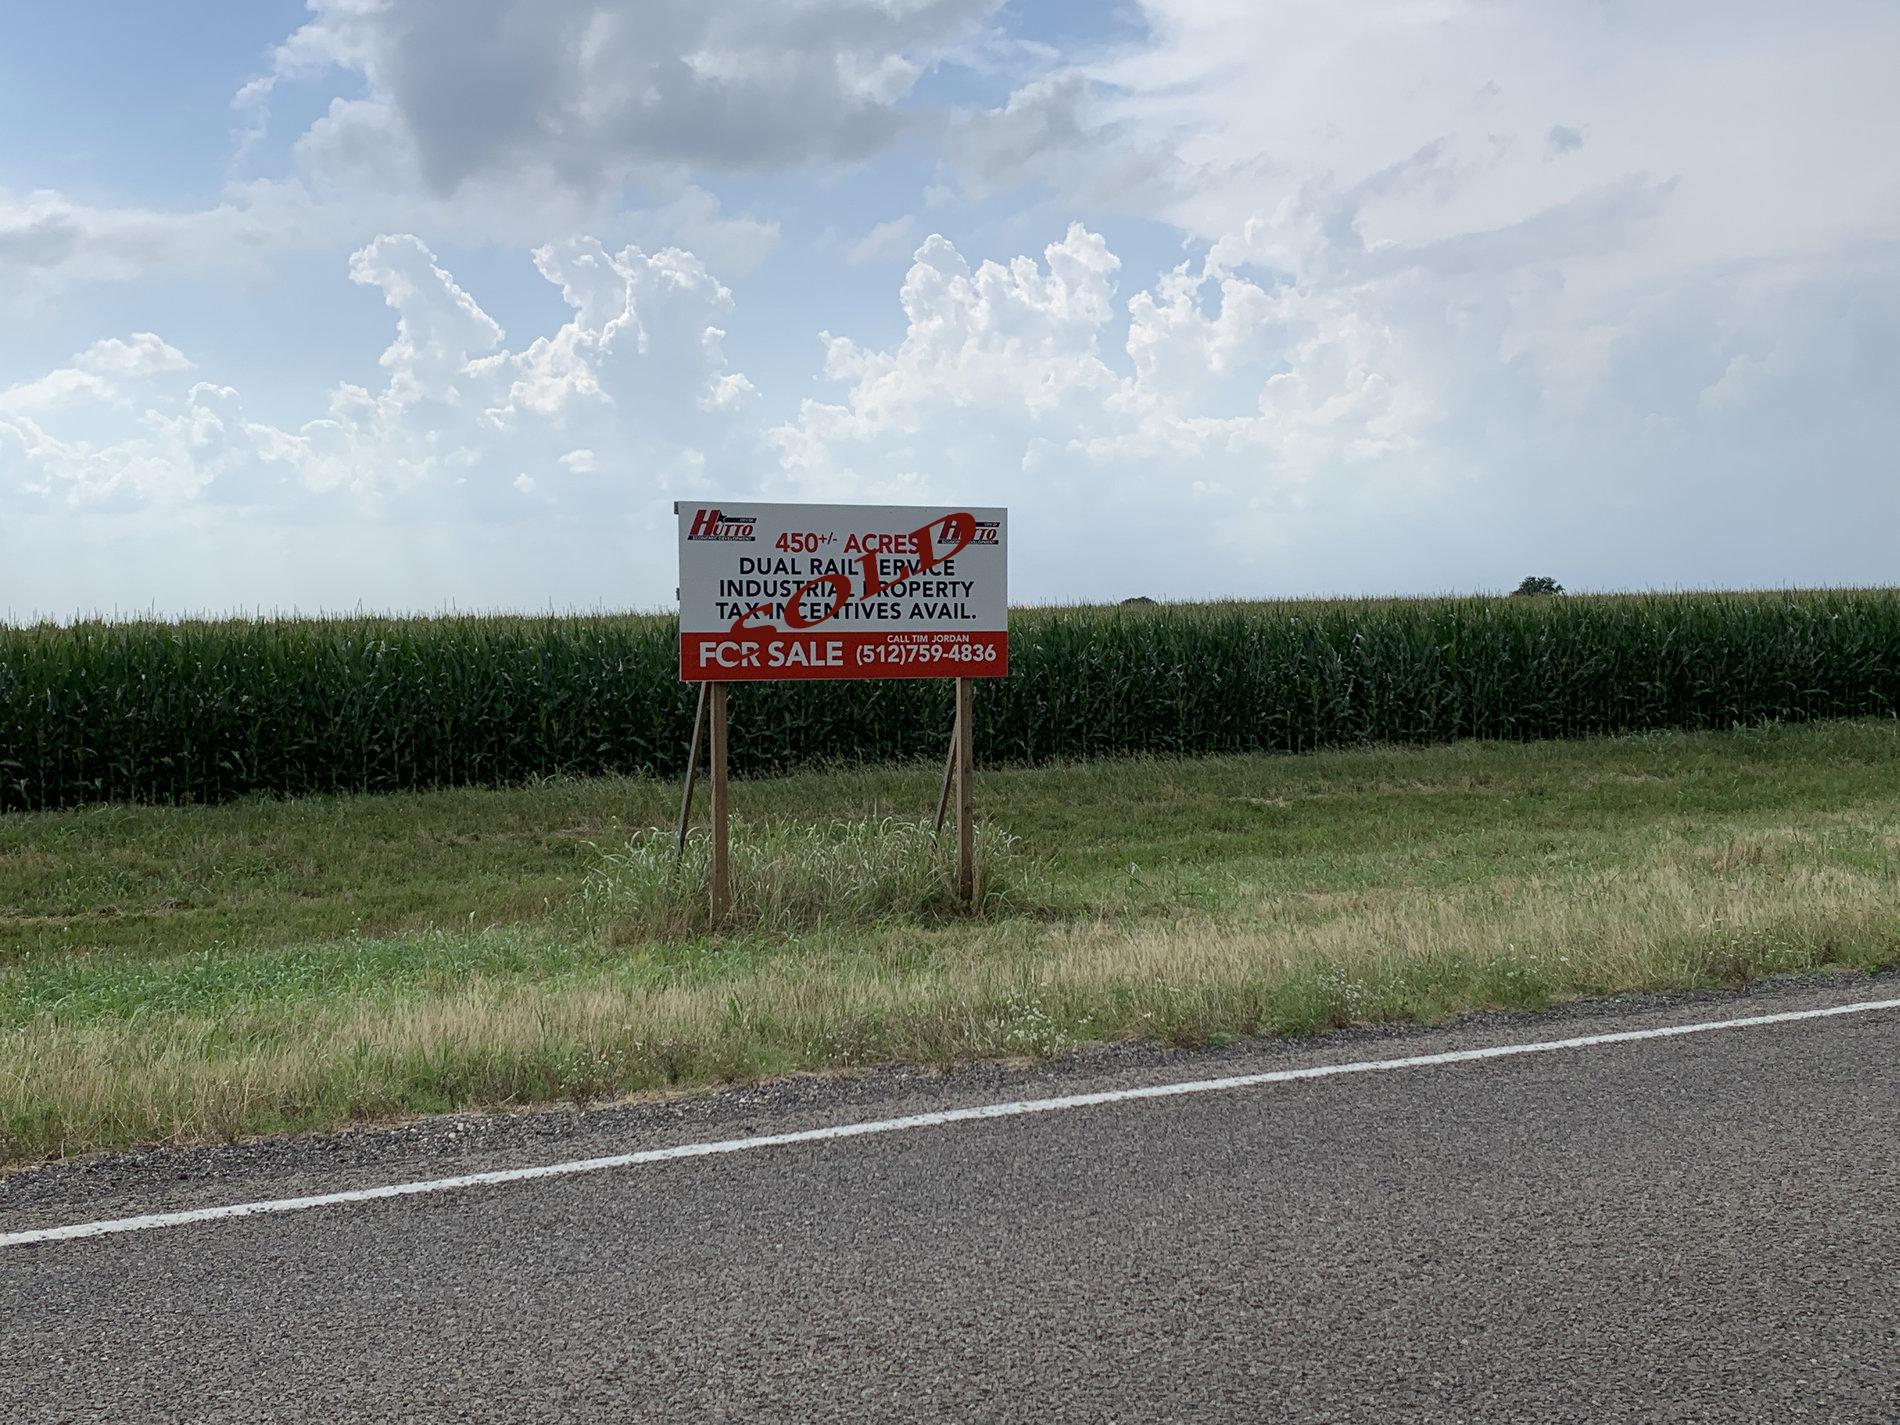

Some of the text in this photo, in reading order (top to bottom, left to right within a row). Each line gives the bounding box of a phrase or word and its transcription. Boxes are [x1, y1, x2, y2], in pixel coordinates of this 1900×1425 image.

[844, 533, 920, 554] ACRES
[740, 557, 801, 575] DUAL
[810, 558, 859, 576] RAIL
[716, 602, 760, 619] TAX
[909, 602, 977, 620] AVAIL.
[887, 635, 969, 643] CALL TIM JORDAN
[699, 641, 844, 668] FOR SALE
[856, 643, 997, 665] (512)759-4836
